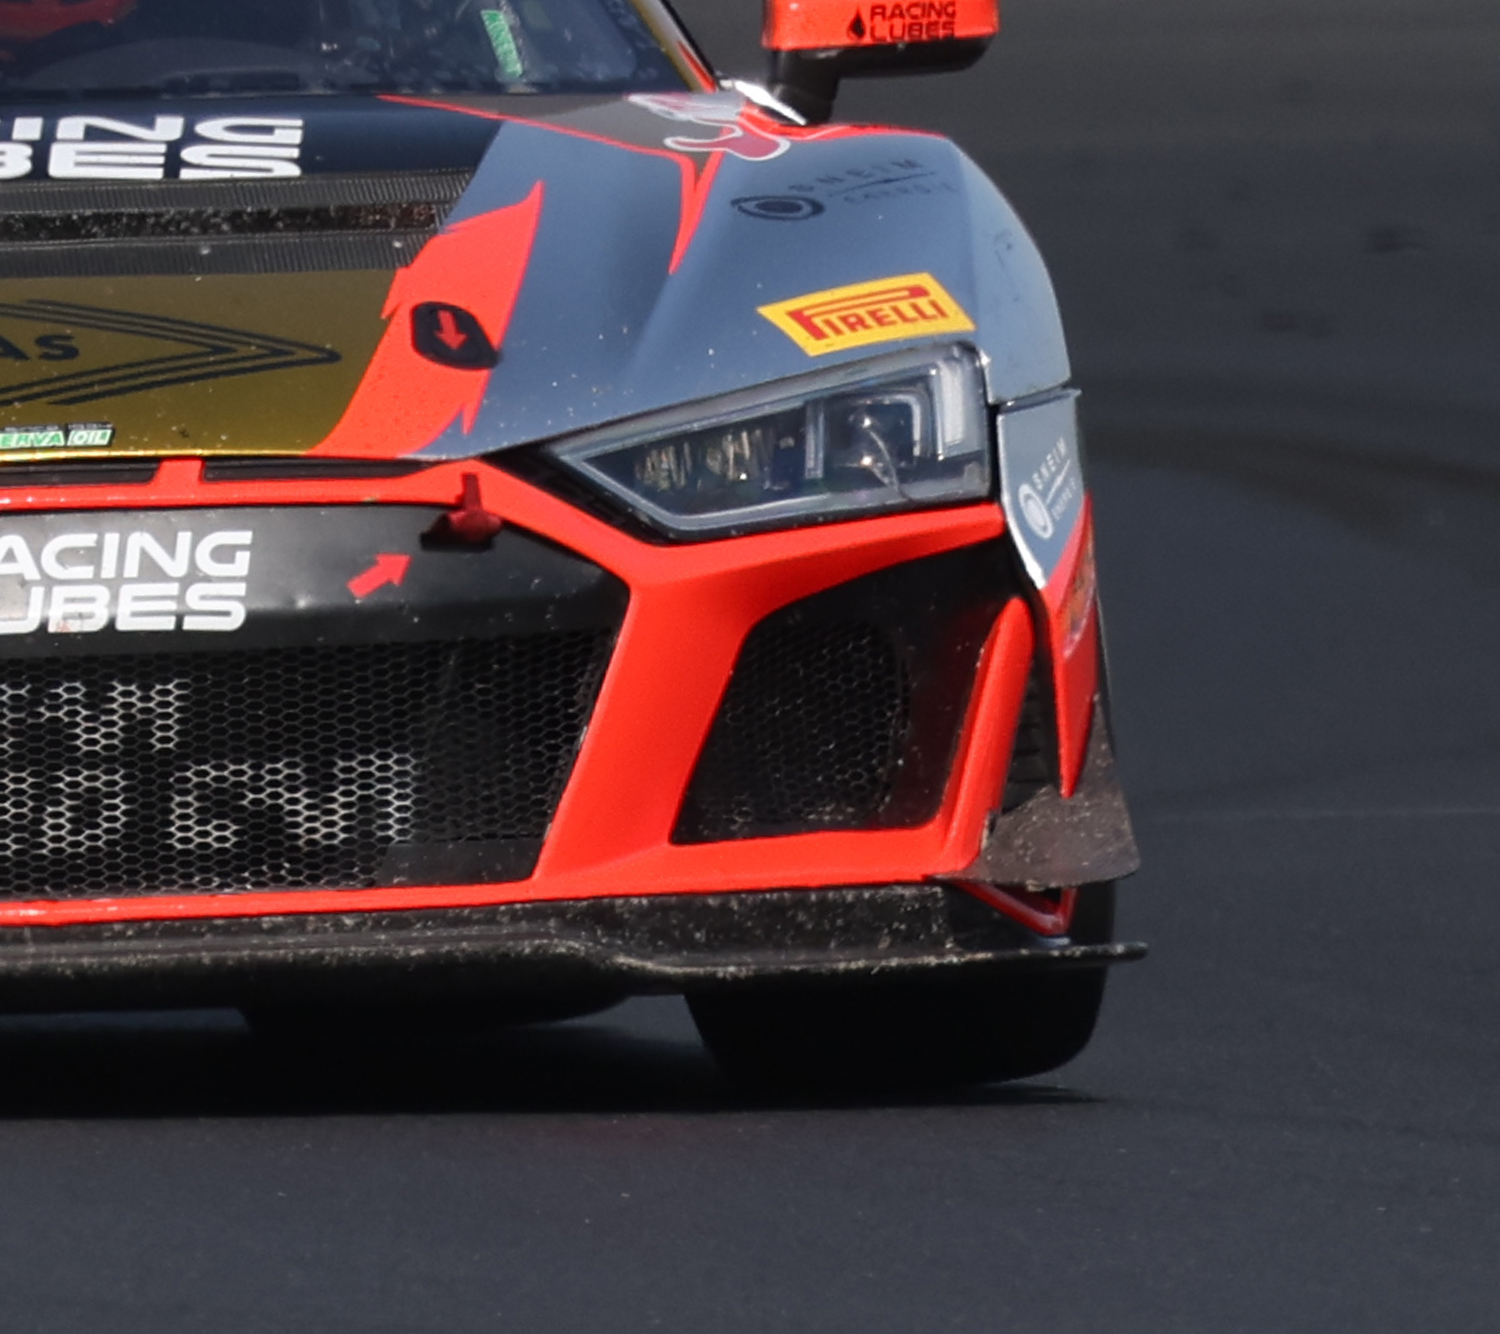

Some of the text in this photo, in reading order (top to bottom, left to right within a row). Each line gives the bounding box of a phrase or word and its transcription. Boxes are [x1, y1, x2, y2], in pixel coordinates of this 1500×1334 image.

[869, 0, 957, 22] RACING
[869, 20, 956, 43] LUBES
[786, 284, 950, 341] PIRELLI
[67, 428, 114, 446] OIL
